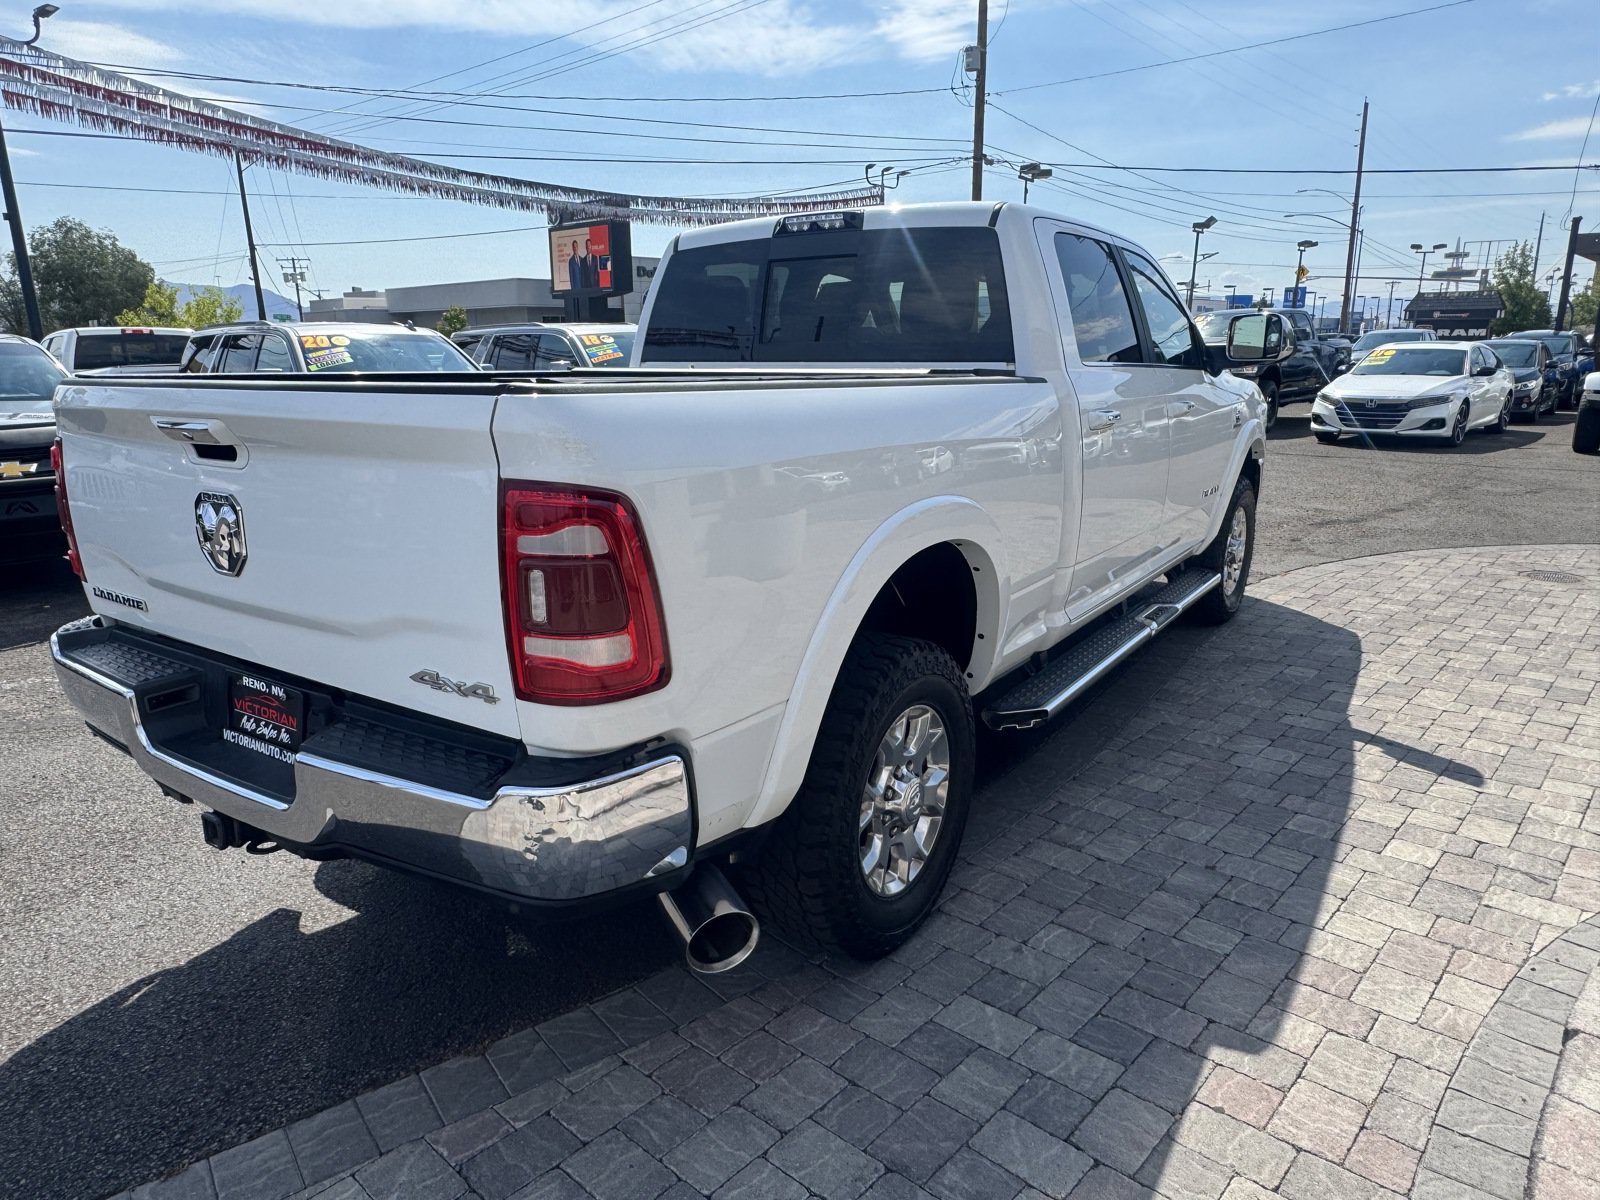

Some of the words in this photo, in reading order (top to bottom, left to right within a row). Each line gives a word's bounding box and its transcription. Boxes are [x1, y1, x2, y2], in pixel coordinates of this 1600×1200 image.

[1436, 328, 1487, 337] RAM
[301, 336, 331, 348] 20
[201, 493, 228, 503] RAM
[92, 586, 148, 612] LARAMIE
[242, 676, 269, 693] RENO,
[233, 698, 297, 729] VICTORIAN
[256, 721, 278, 740] Sales
